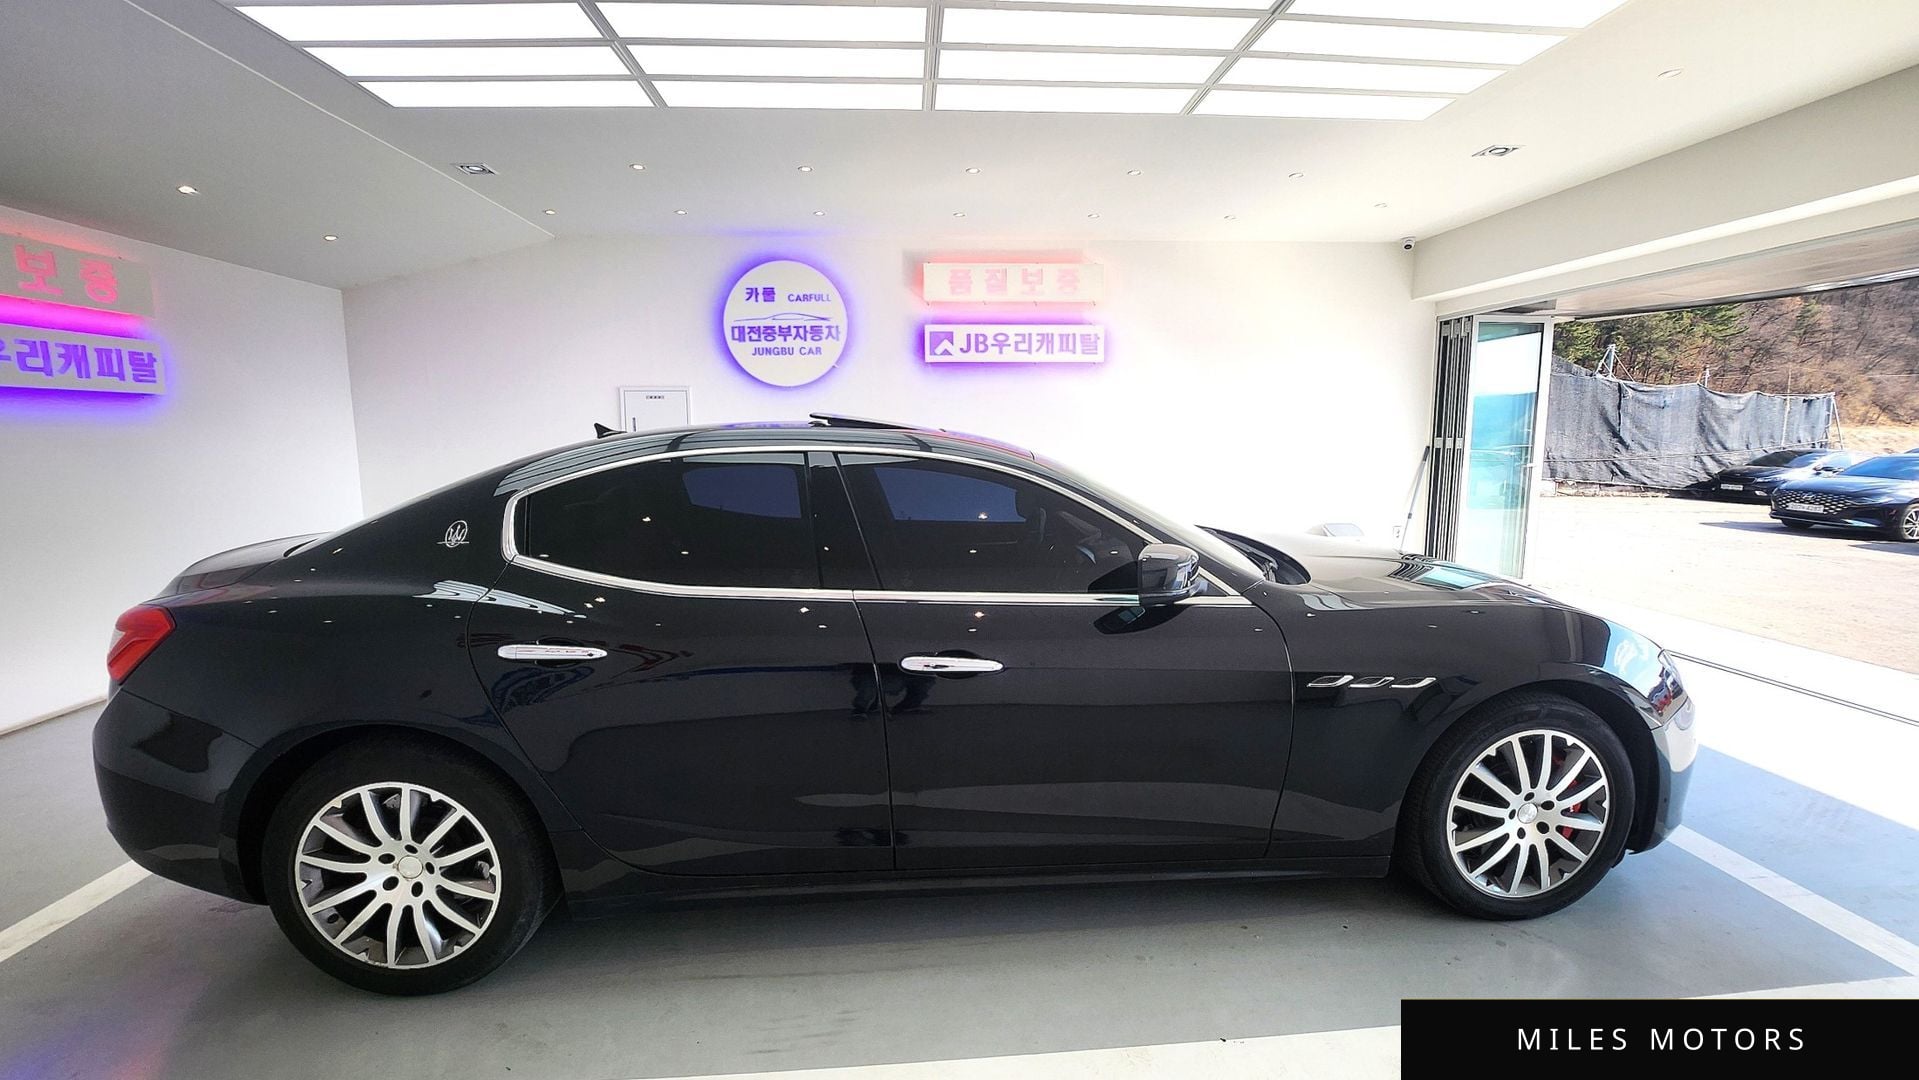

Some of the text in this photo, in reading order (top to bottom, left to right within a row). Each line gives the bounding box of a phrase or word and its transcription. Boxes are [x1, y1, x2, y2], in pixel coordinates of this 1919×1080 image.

[787, 293, 832, 302] CARFULL
[959, 332, 1101, 355] JB우리캐피탈
[752, 347, 822, 356] JUNGBU CAR
